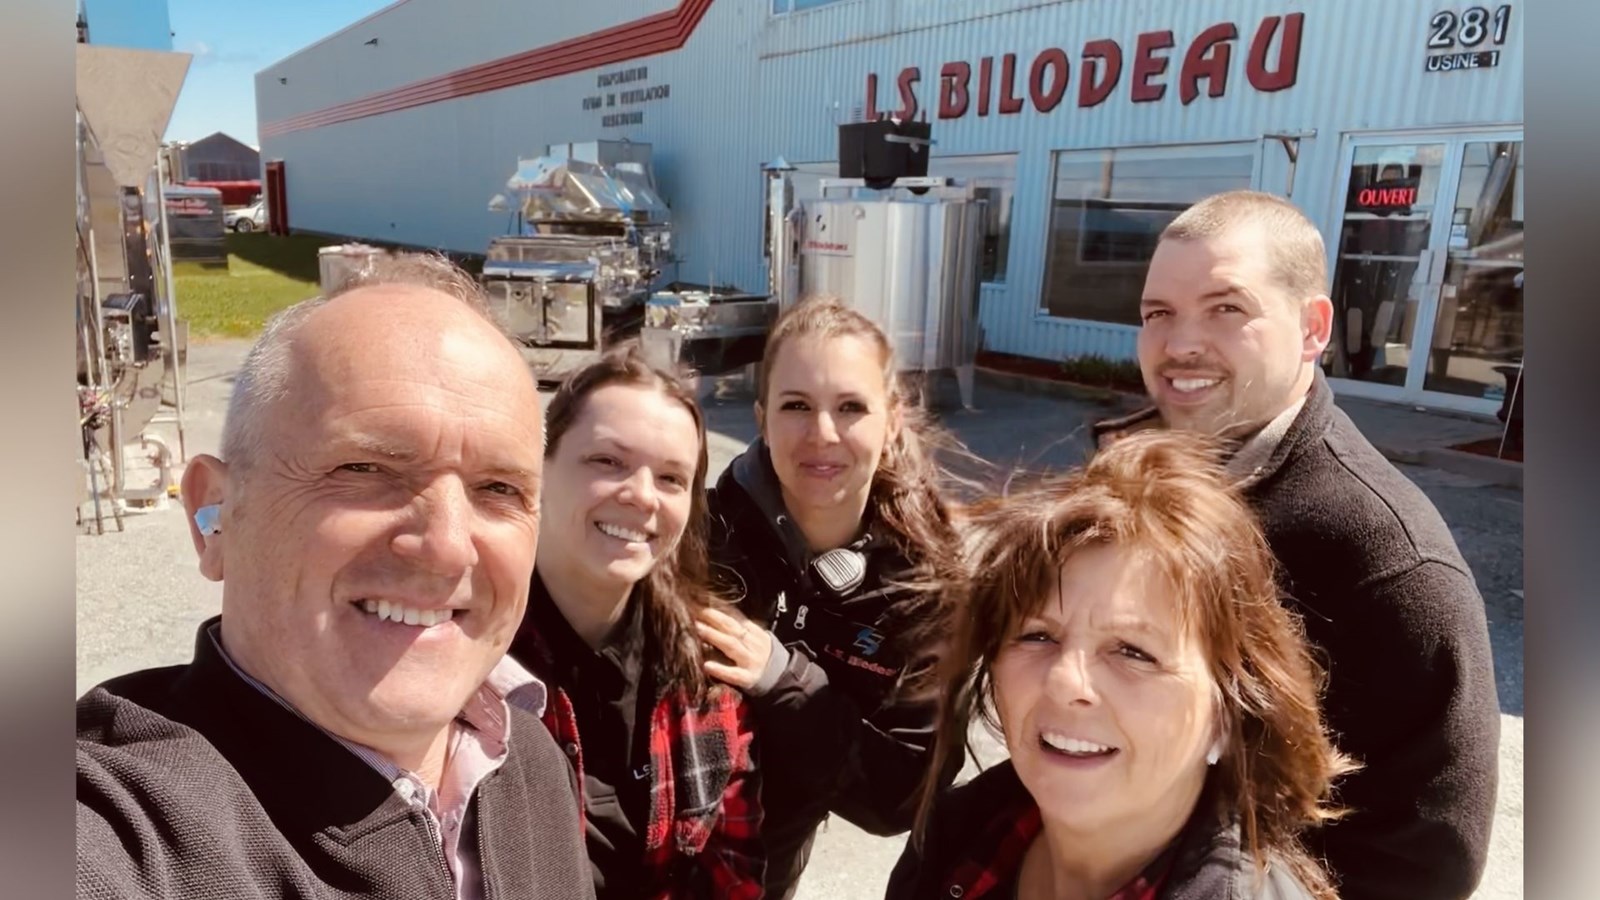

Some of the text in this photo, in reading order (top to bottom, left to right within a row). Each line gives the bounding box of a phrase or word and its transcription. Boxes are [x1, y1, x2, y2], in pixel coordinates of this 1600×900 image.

[1428, 5, 1511, 49] 281
[938, 13, 1304, 119] BILODEAU
[1427, 53, 1480, 71] USINE
[1359, 187, 1416, 206] OUVERT
